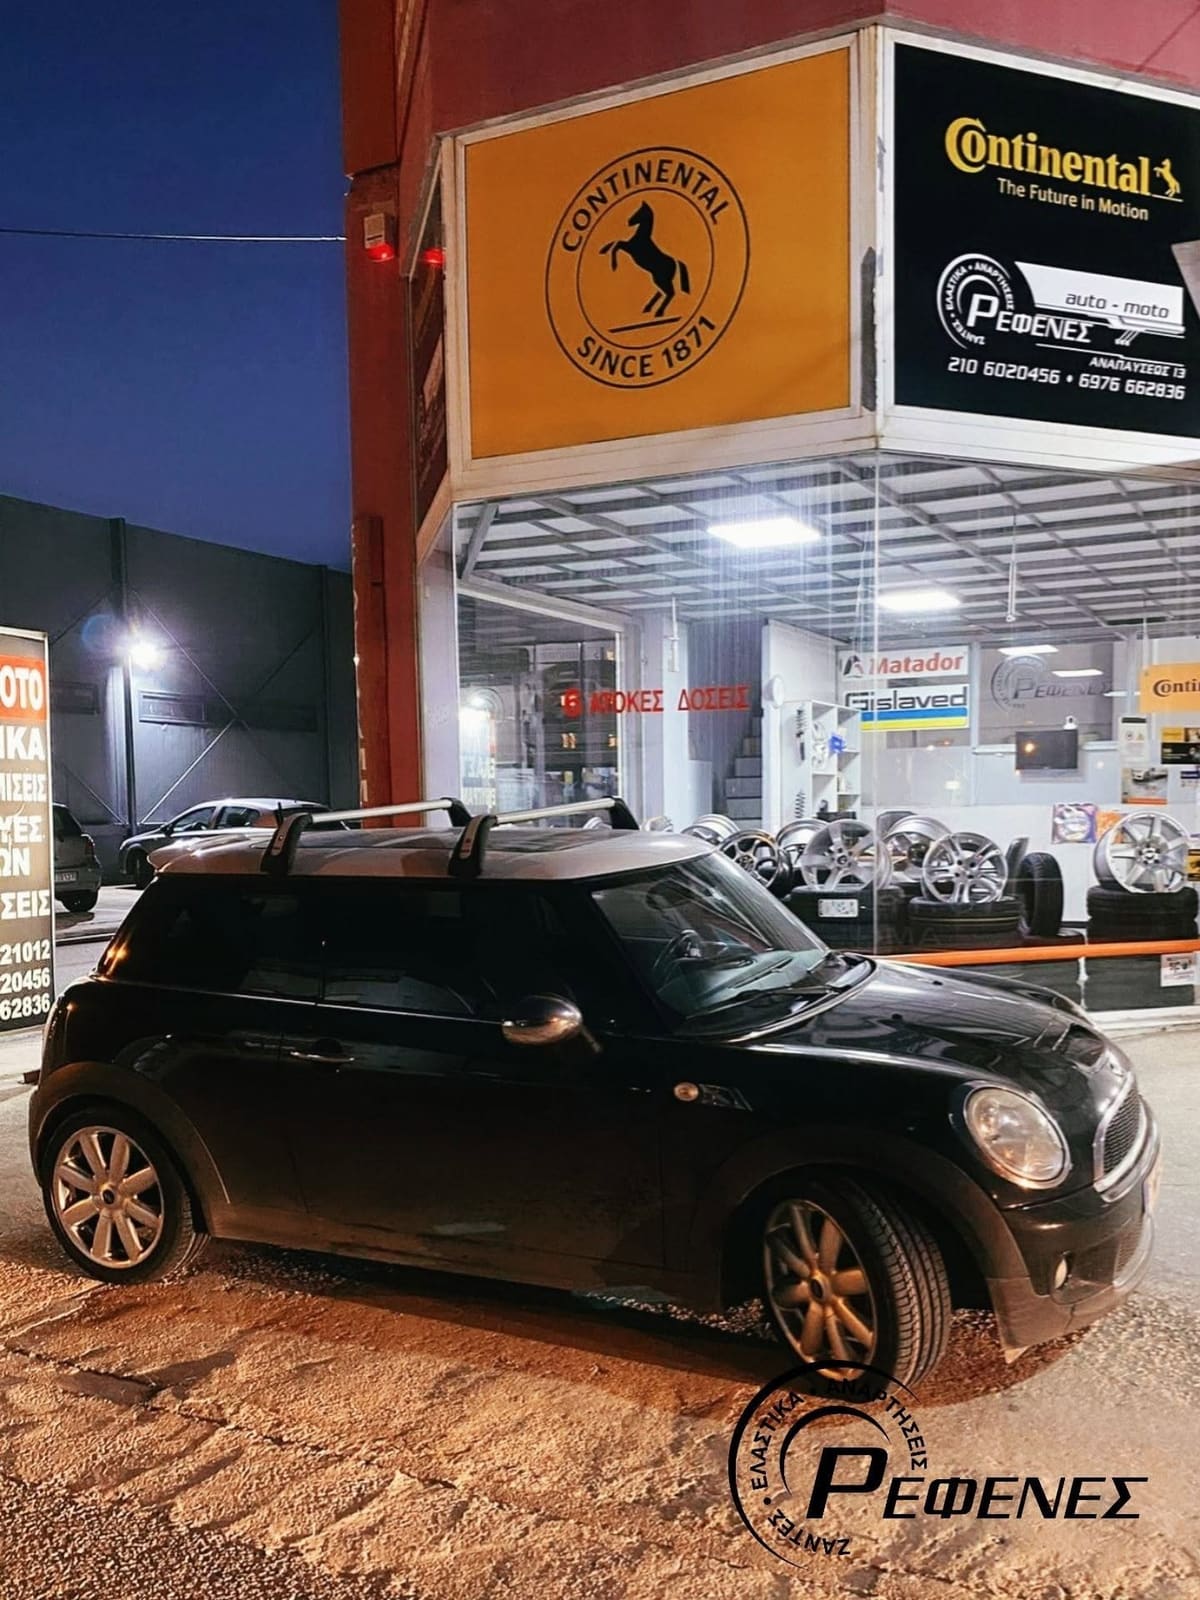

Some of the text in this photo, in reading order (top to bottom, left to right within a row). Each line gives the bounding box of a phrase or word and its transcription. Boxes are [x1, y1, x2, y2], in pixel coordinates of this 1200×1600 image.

[945, 116, 1150, 196] Continental
[562, 159, 729, 252] CONTINENTAL
[997, 177, 1149, 222] The Future in Motion
[1065, 291, 1107, 310] auto
[1123, 301, 1169, 319] moto
[577, 316, 716, 379] SINCE 1871
[948, 356, 1186, 400] 210 6020456 6976 662836
[1088, 355, 1187, 379] ΑΝΑΠΑΥΣΕΩΣ 13
[868, 652, 964, 676] Matador
[677, 684, 750, 712] ΔΟΣΕΙΣ
[845, 686, 968, 711] Gislaved
[0, 938, 50, 966] 21012
[0, 967, 50, 995] 20456
[0, 992, 51, 1021] 62836
